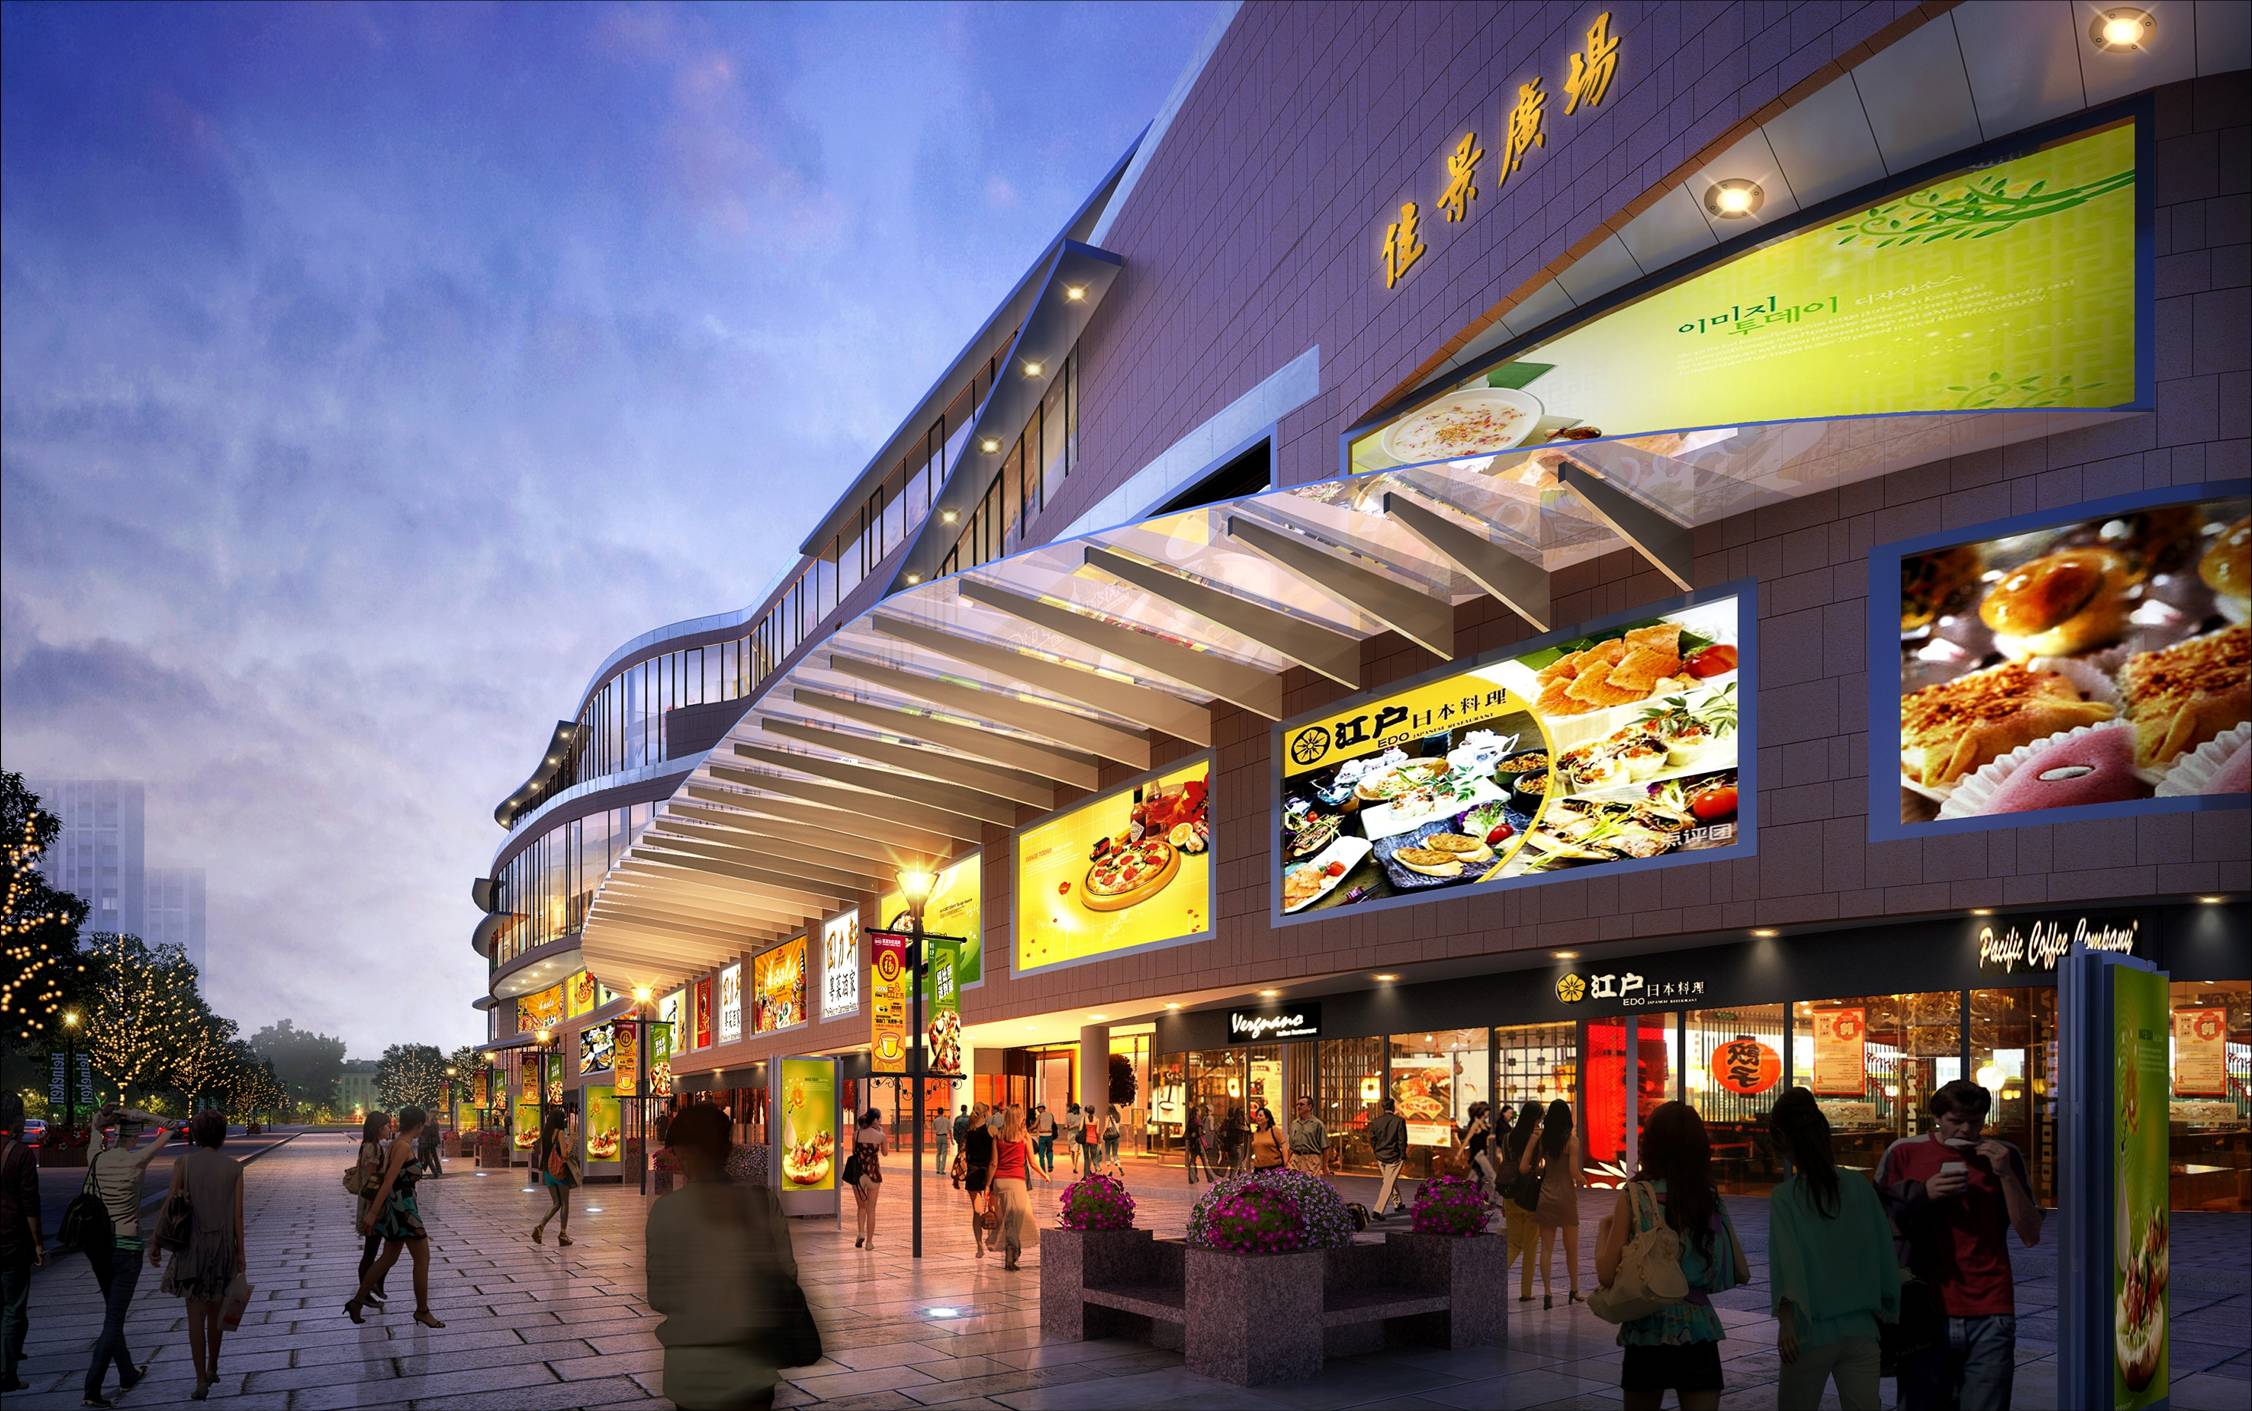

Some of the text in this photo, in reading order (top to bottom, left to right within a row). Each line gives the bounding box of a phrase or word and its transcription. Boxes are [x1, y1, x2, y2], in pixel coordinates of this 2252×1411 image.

[1381, 11, 1621, 288] 佳景廣場
[1677, 296, 1776, 334] 이미지
[1728, 296, 1838, 336] 투데이
[1412, 687, 1507, 729] 日本料理
[1378, 732, 1410, 748] EDO
[1979, 925, 2024, 974] Pacific
[2028, 920, 2069, 970] Coffee
[1623, 997, 1645, 1006] EDO
[1647, 981, 1705, 998] 日本料理
